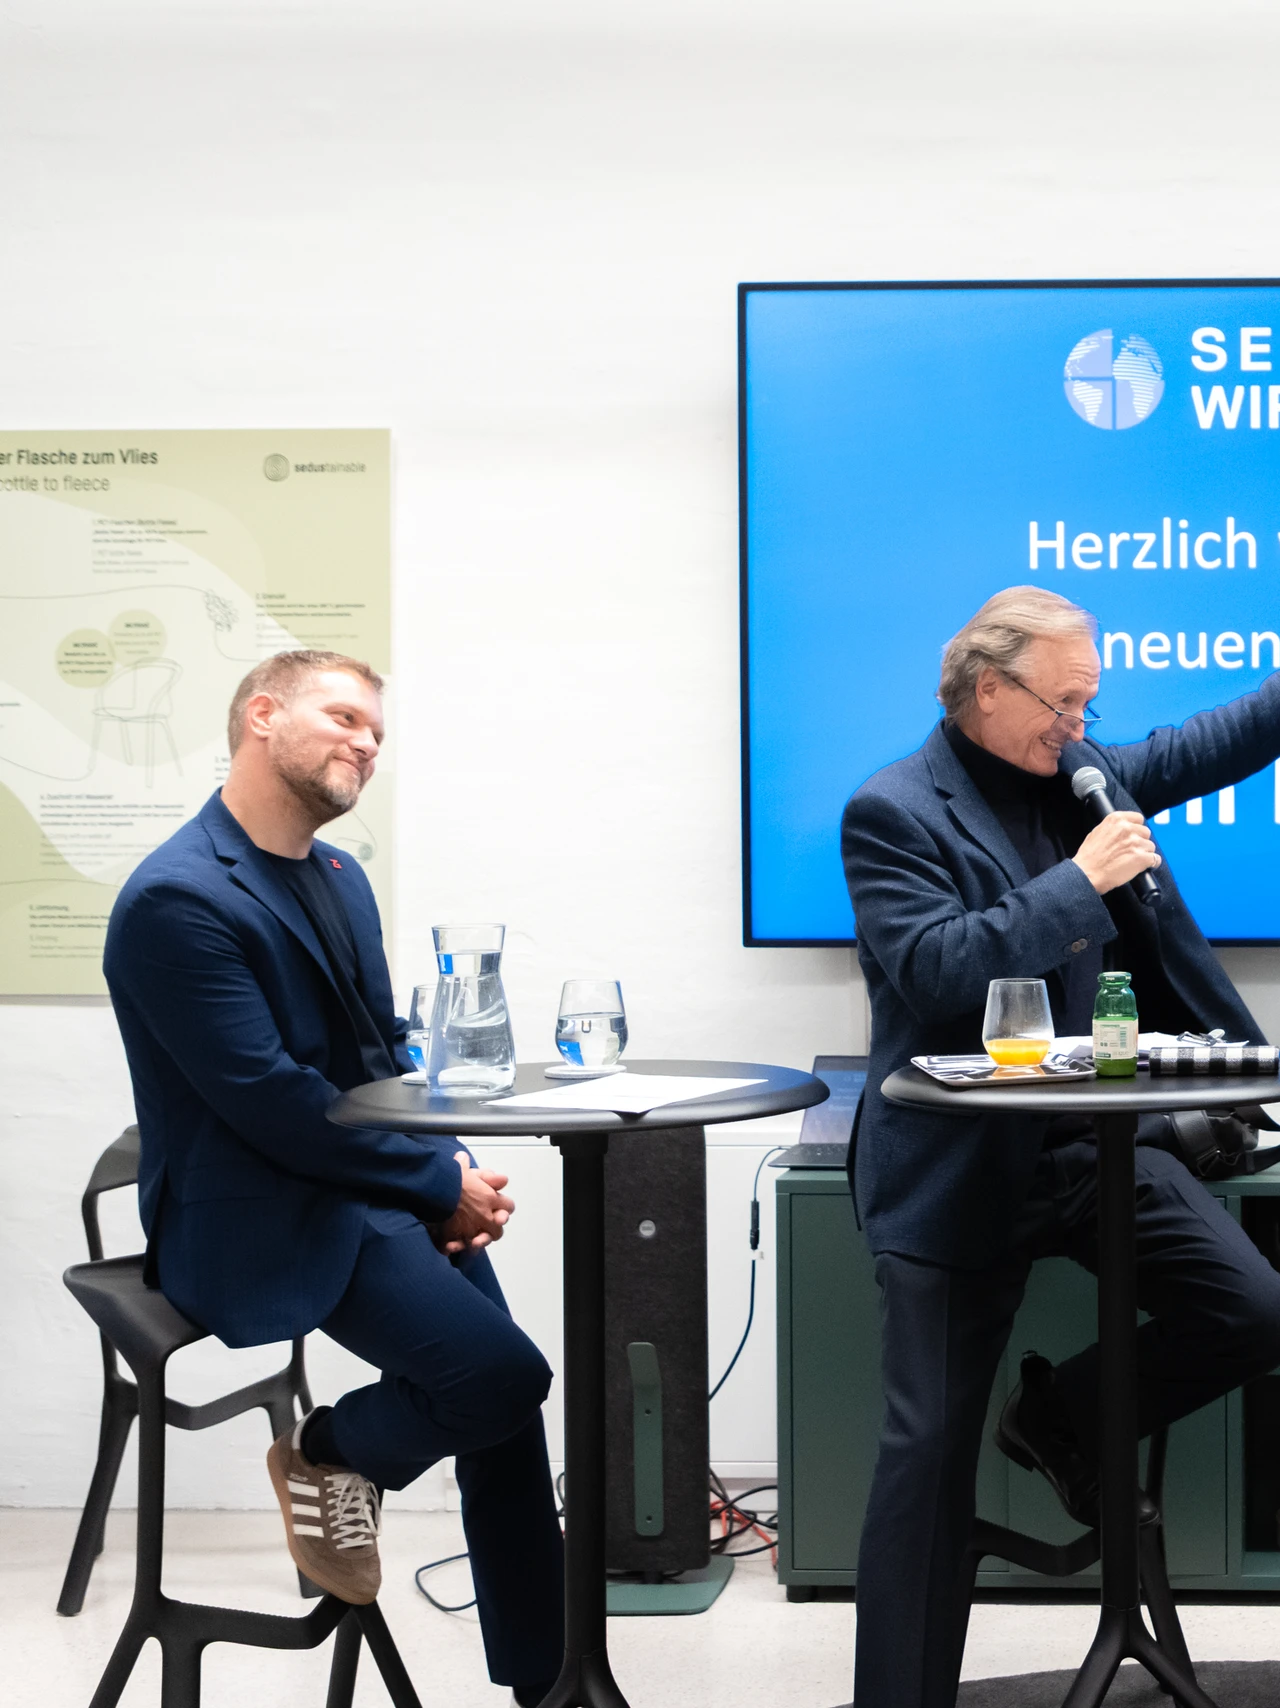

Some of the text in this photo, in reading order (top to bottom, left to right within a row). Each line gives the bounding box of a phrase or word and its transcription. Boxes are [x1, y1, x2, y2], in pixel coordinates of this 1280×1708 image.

[16, 449, 78, 465] Flasche
[82, 451, 115, 465] zum
[119, 449, 159, 465] Vlies
[43, 476, 59, 491] to
[63, 475, 110, 491] fleece
[1027, 516, 1257, 569] Herzlich
